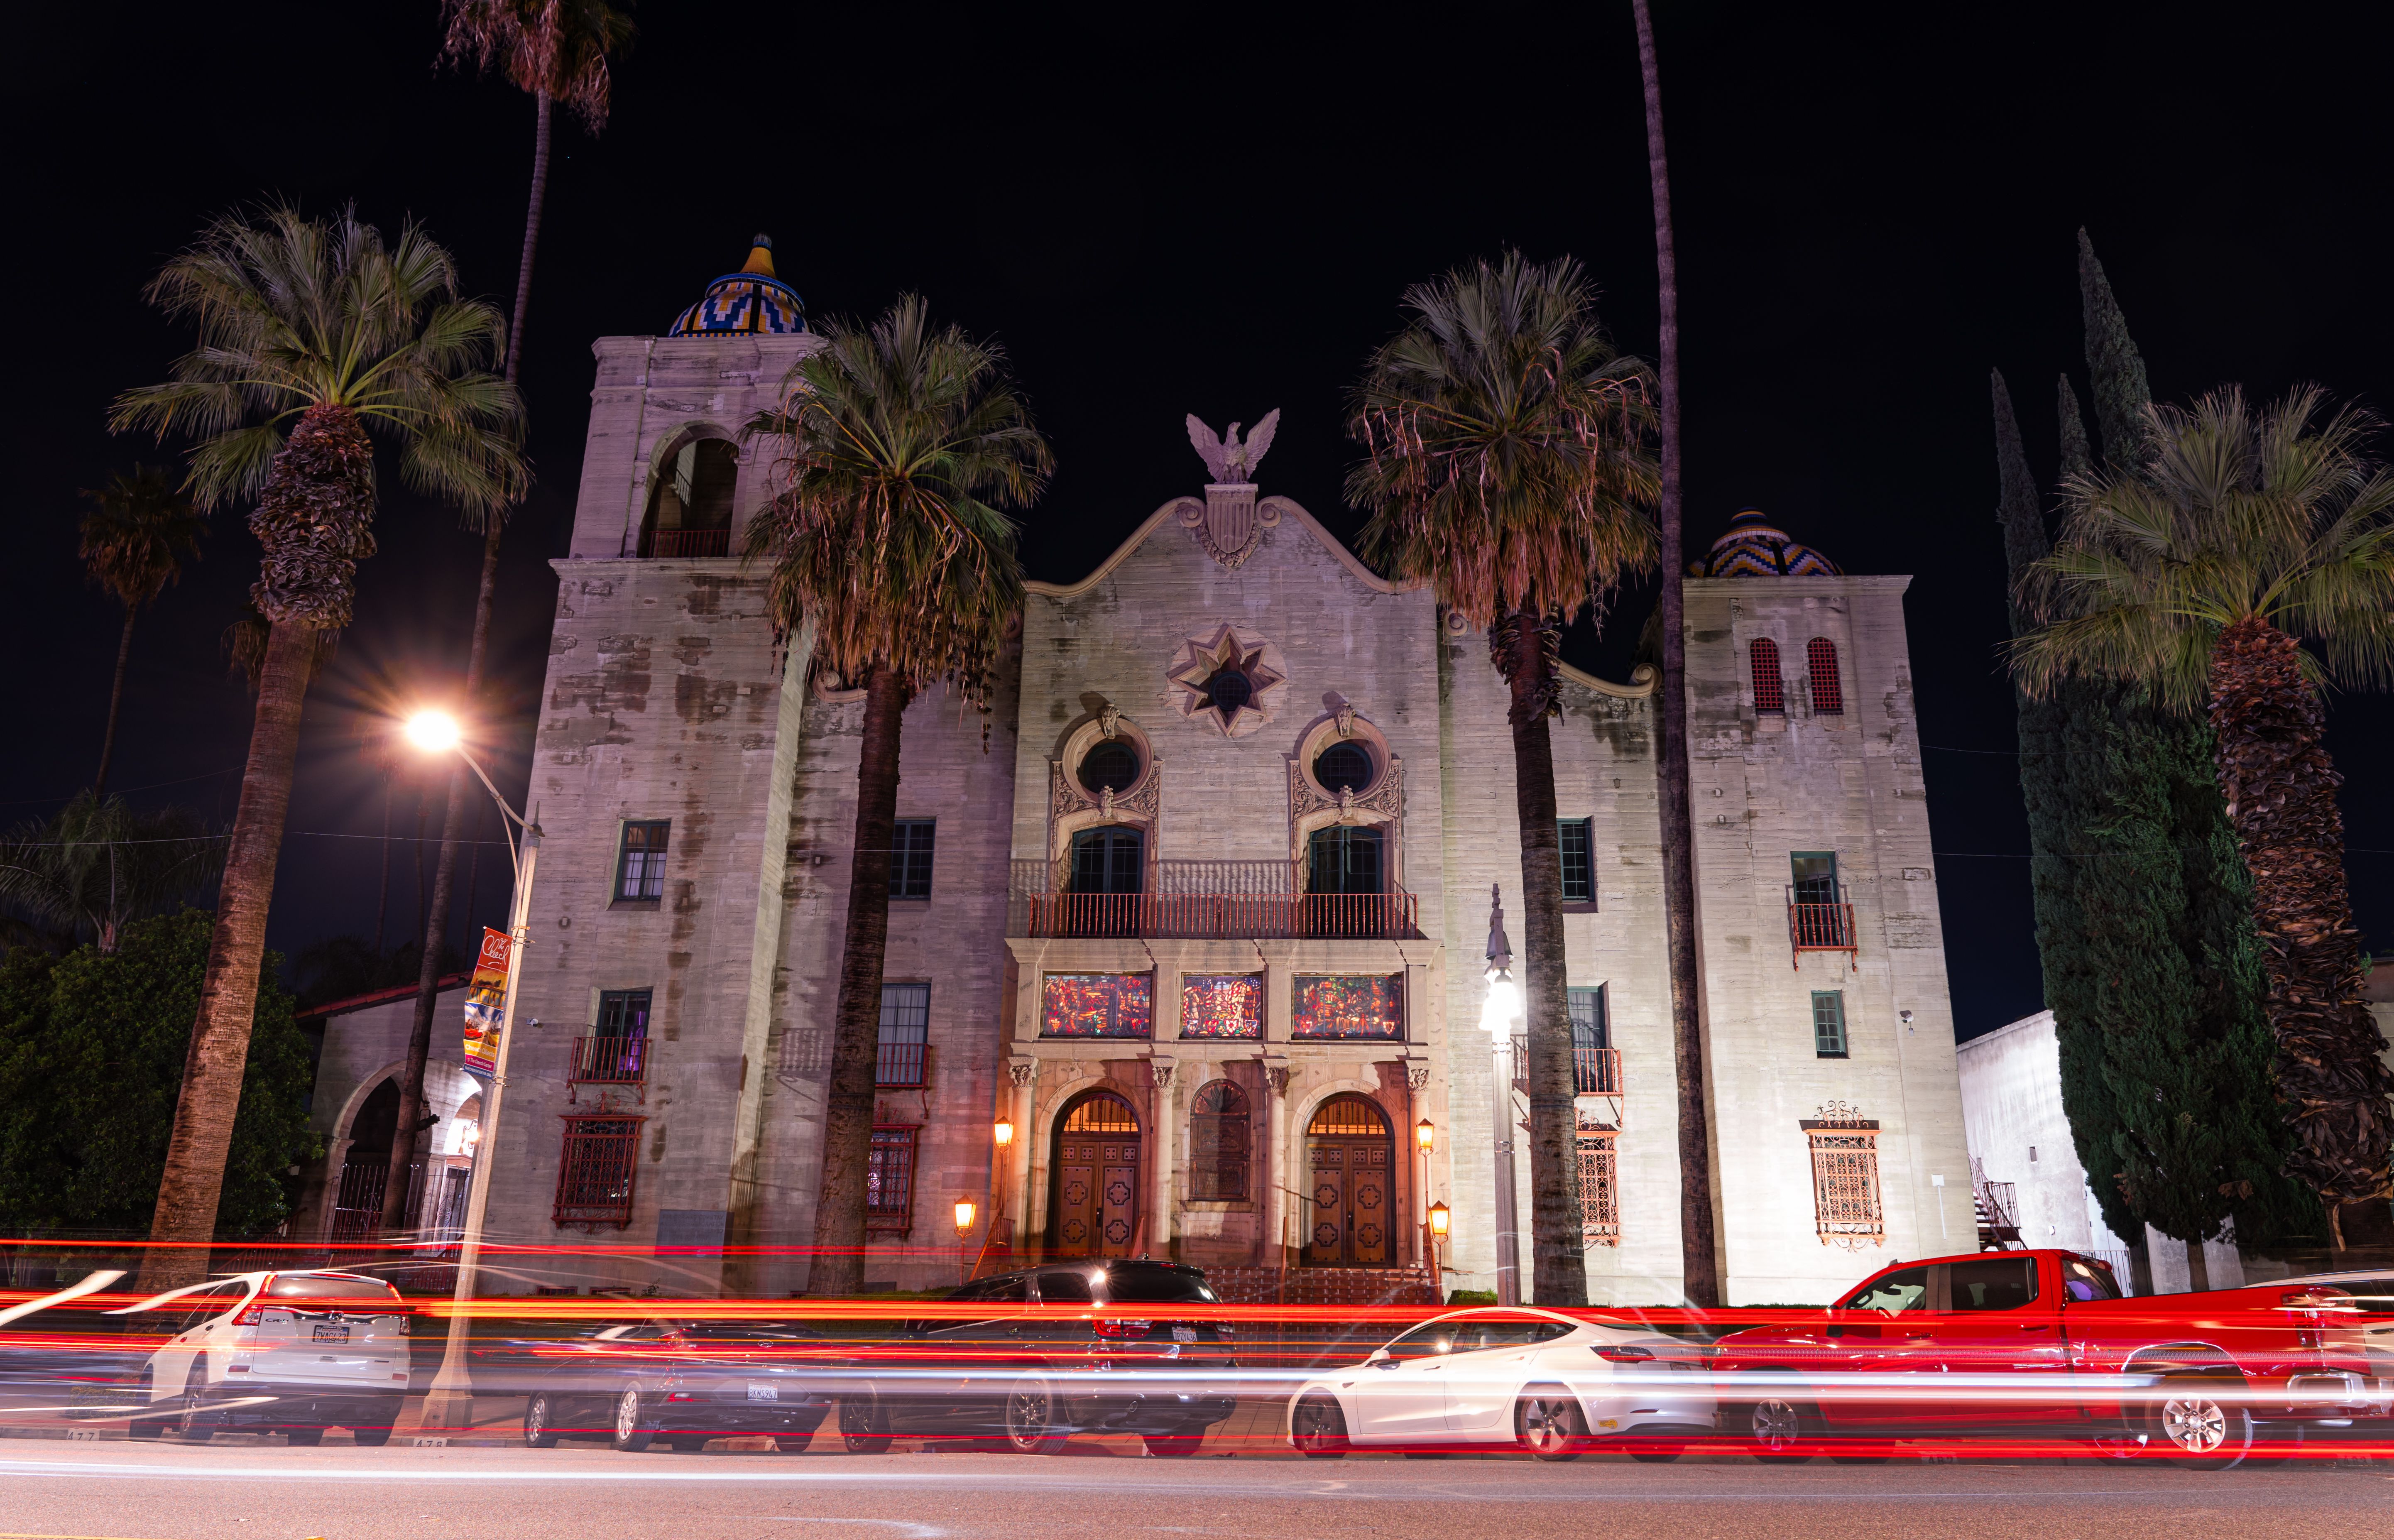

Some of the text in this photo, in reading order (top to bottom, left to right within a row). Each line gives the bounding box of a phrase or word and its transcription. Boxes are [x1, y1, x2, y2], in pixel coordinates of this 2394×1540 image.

[482, 935, 510, 965] Cheech
[465, 1044, 482, 1053] Cheech
[1173, 1332, 1196, 1342] 7PZY436
[749, 1389, 777, 1398] 8KNS947
[68, 1432, 95, 1441] 477
